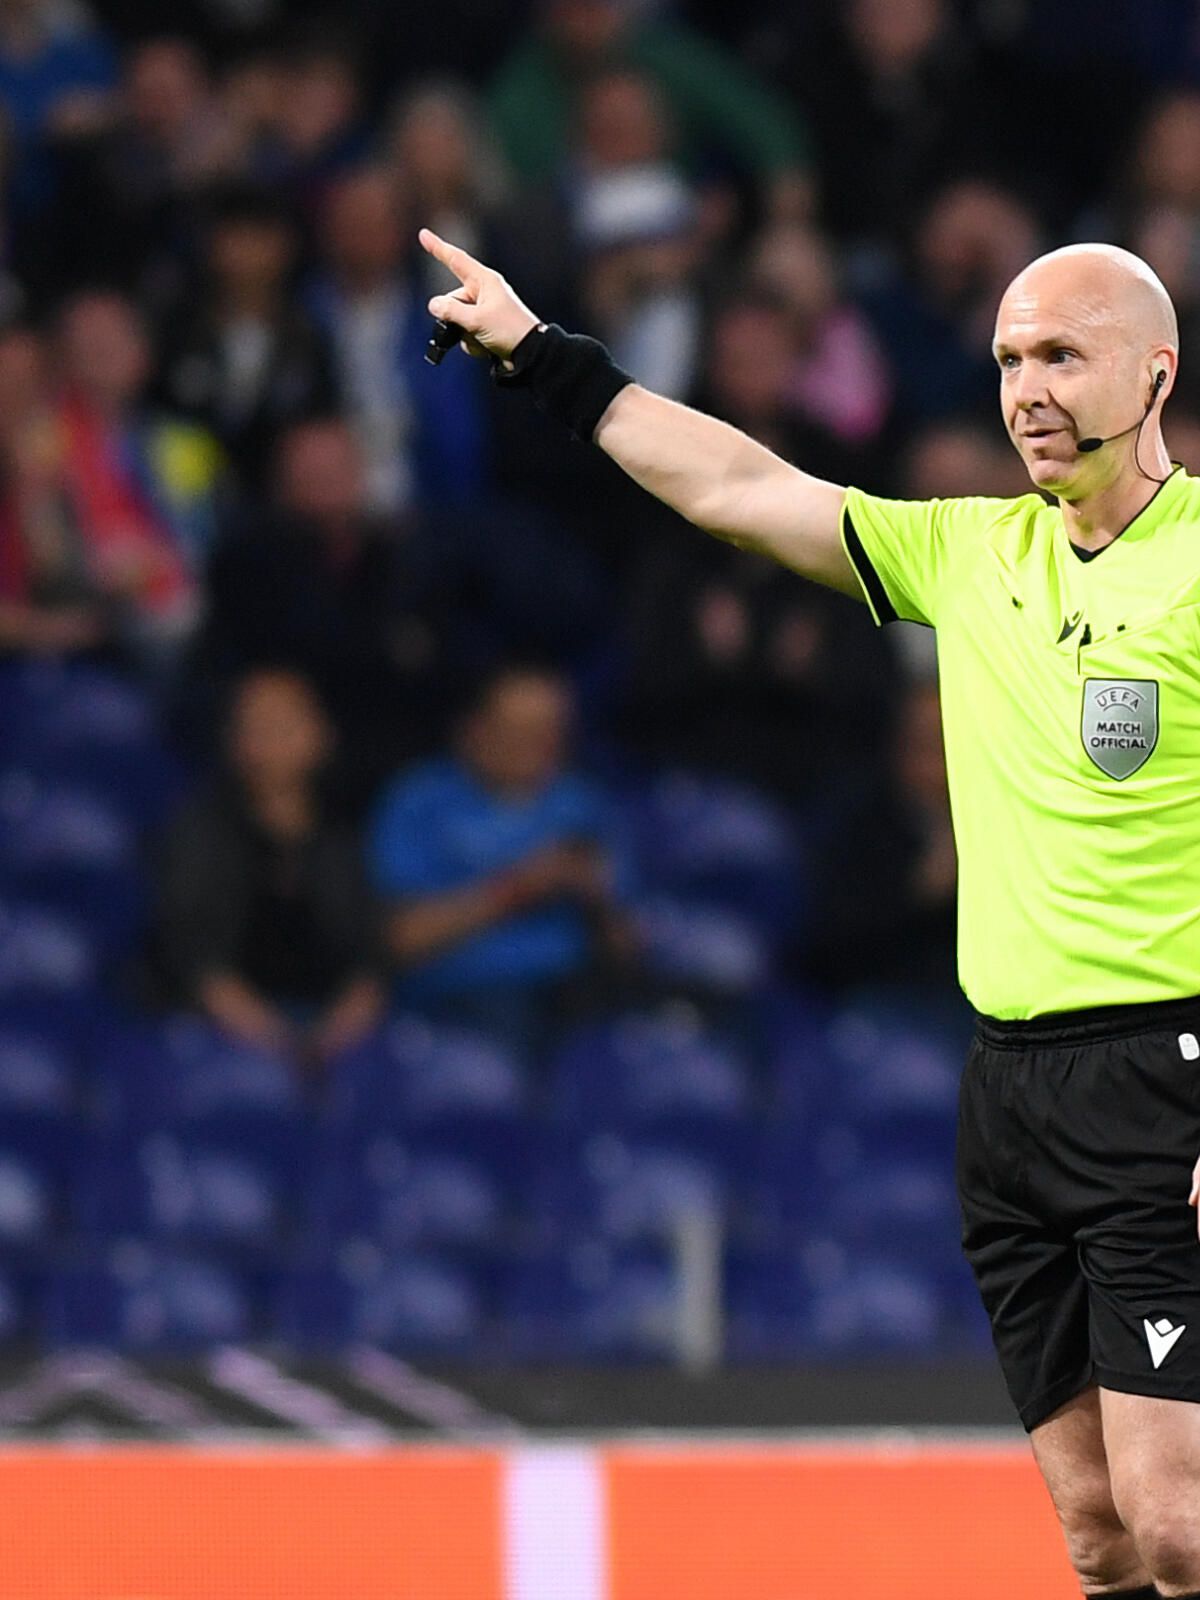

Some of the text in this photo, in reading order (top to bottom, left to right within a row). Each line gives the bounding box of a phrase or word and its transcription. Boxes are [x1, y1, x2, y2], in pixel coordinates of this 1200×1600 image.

[1096, 690, 1140, 709] UEFA
[1096, 721, 1141, 734] MATCH
[1090, 737, 1147, 749] OFFICIAL
